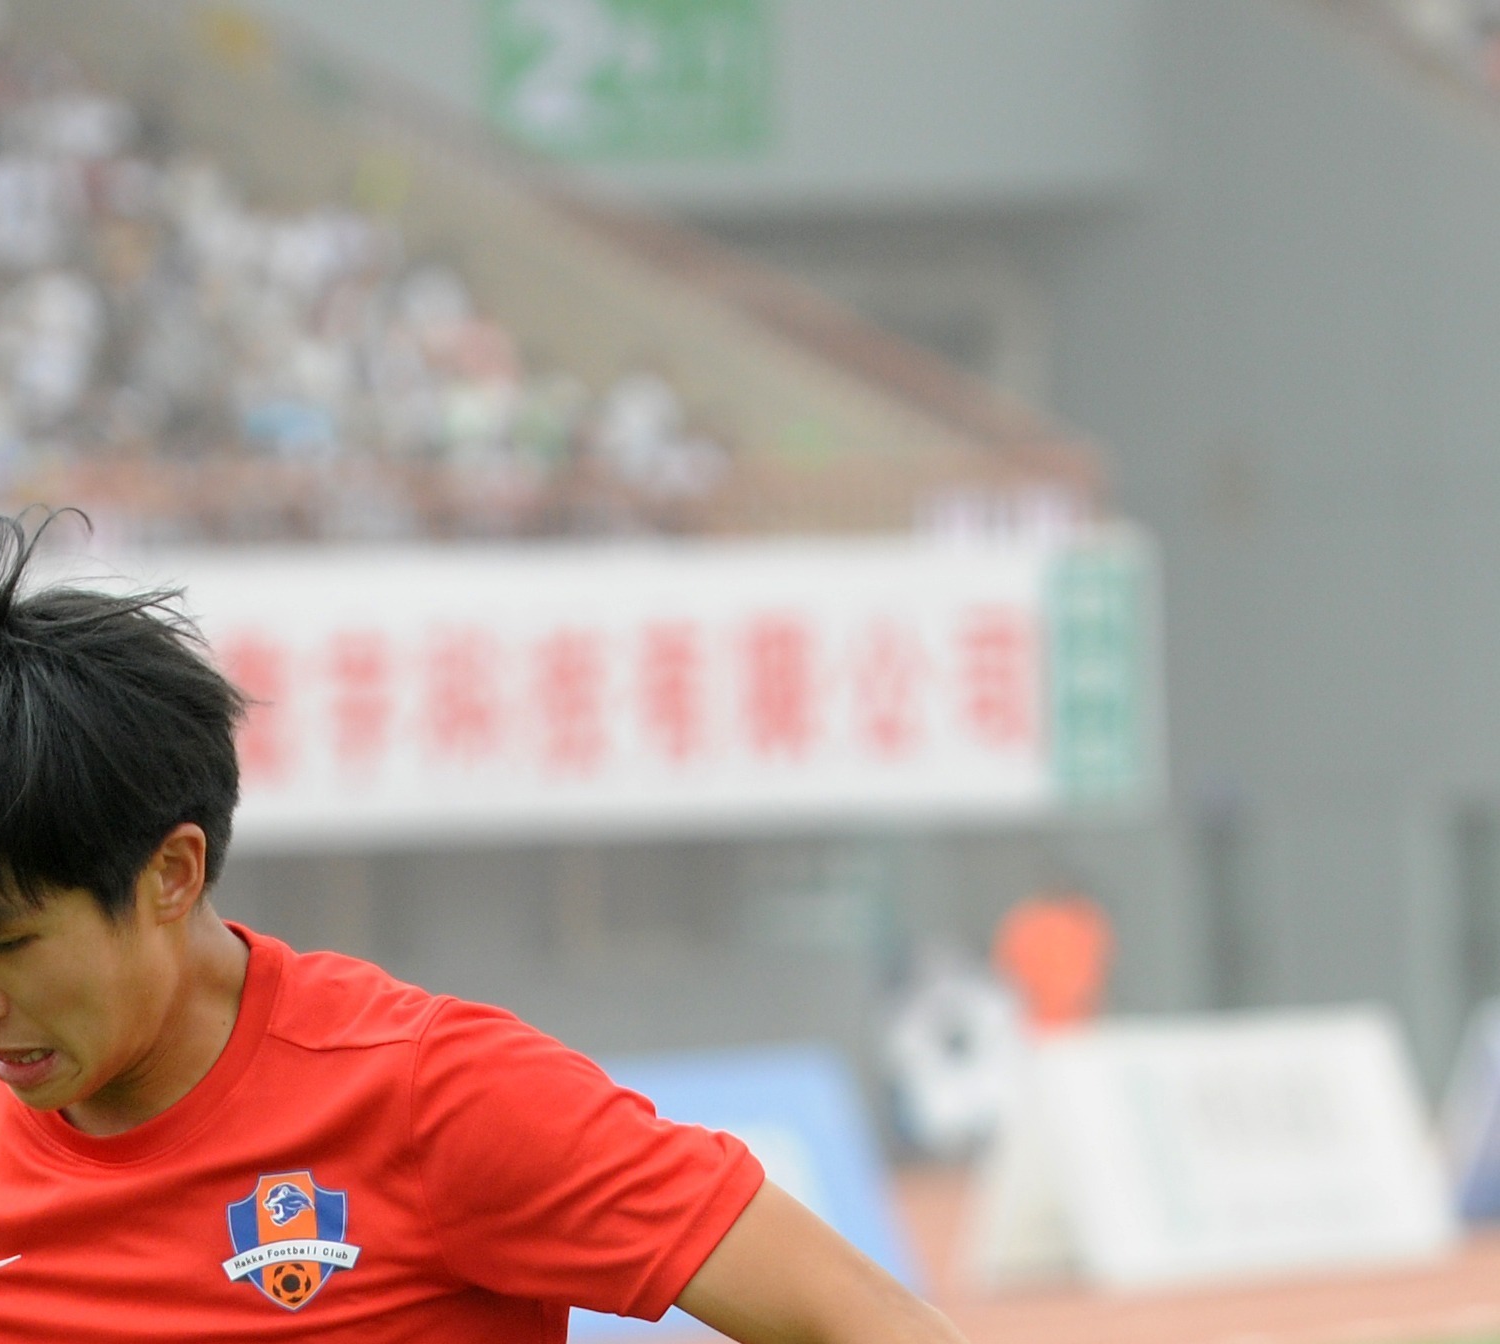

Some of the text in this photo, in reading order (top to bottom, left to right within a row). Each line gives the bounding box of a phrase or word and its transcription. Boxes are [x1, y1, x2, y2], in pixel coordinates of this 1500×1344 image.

[233, 1246, 348, 1270] Hakka Football Club
